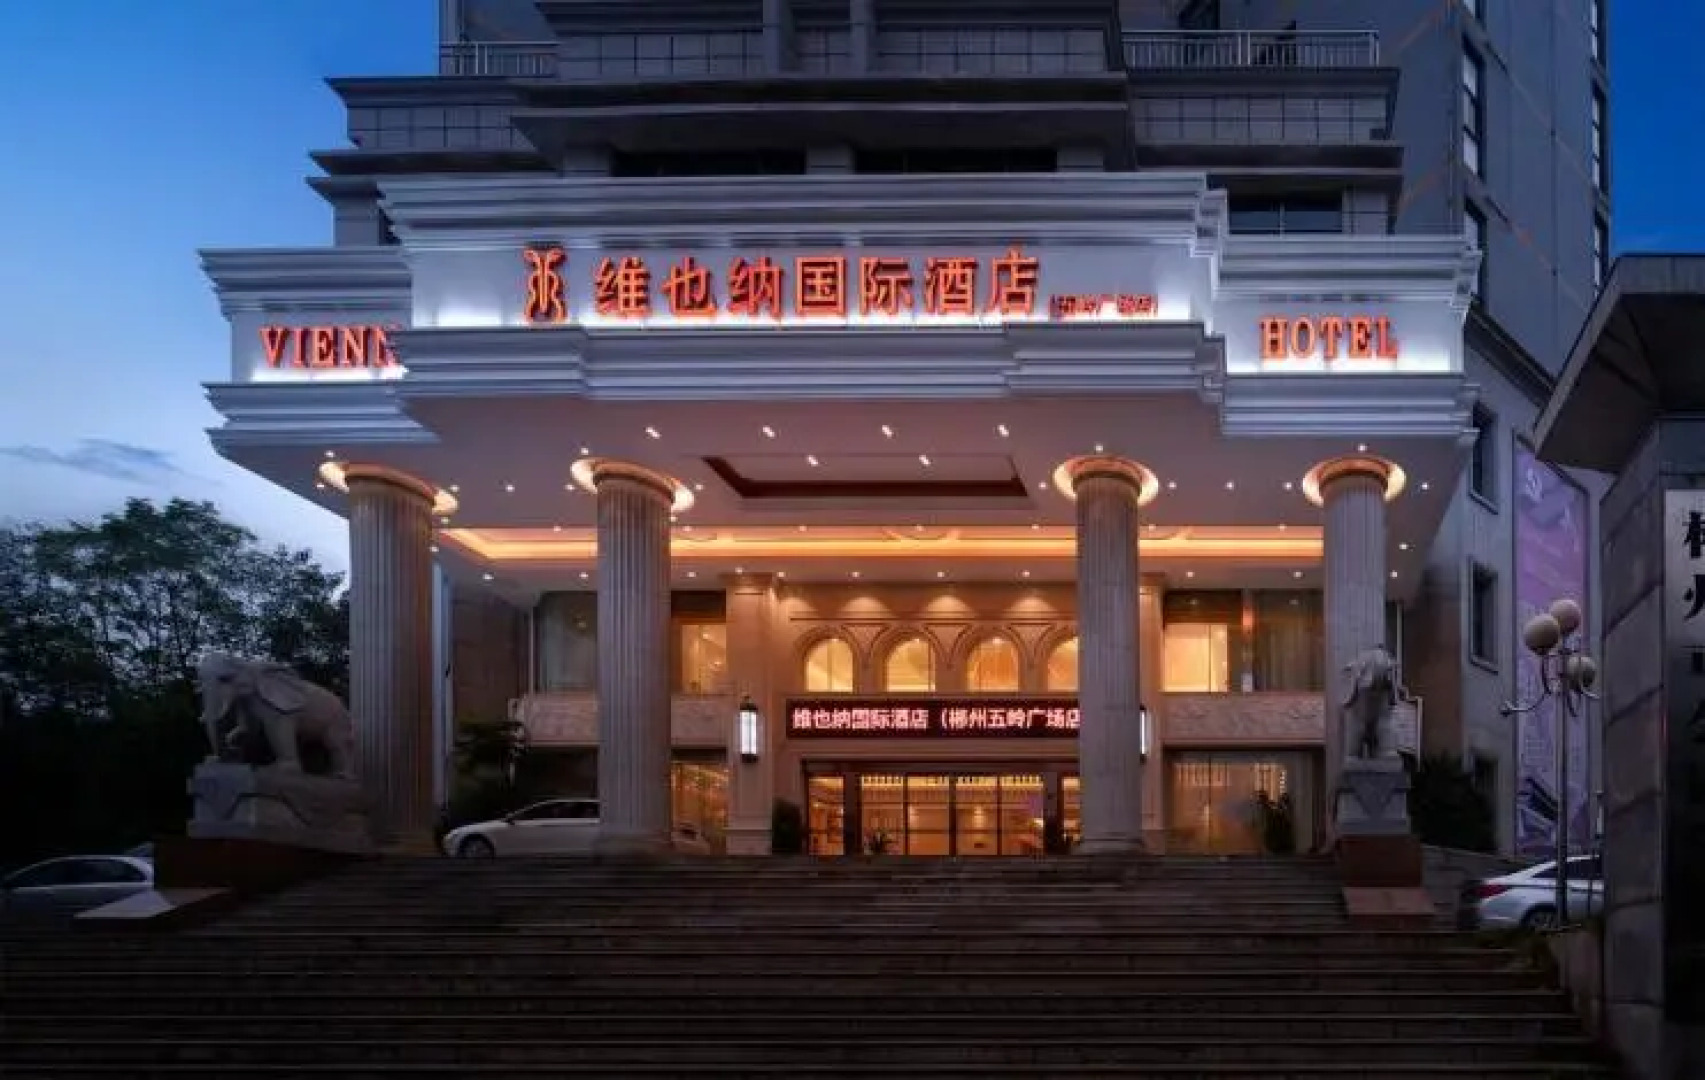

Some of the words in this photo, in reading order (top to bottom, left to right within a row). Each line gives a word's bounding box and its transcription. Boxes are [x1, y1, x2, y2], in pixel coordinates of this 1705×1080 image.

[595, 249, 1040, 320] 维也纳国际酒店
[1259, 315, 1396, 360] HOTEL
